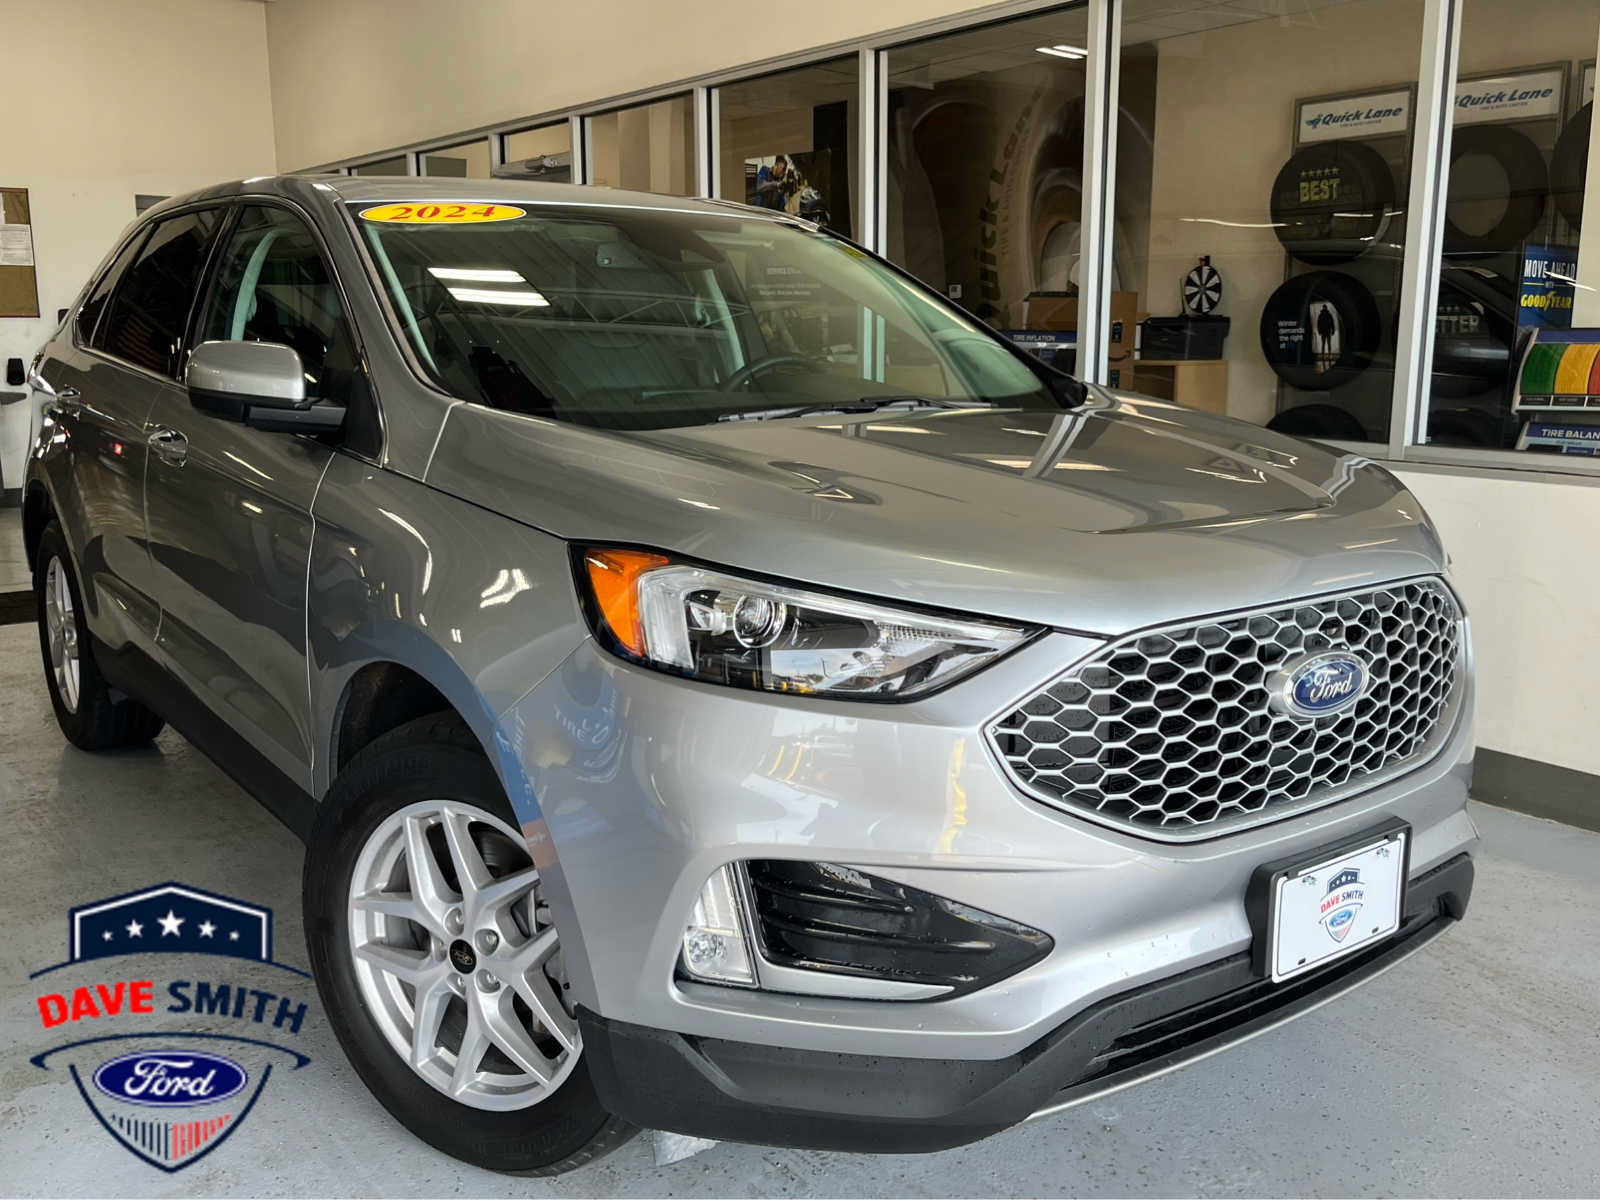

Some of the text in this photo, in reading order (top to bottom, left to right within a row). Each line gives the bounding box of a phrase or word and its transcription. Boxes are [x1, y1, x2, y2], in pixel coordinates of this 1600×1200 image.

[1459, 91, 1505, 108] Quick
[1508, 88, 1553, 102] Lane
[1322, 110, 1363, 126] Quick
[1365, 107, 1404, 120] Lane
[1299, 178, 1341, 202] BEST
[390, 206, 496, 220] 2024
[1524, 259, 1548, 278] MOVE
[1521, 291, 1572, 311] GOODYEAR
[1541, 428, 1564, 438] TIRE
[1310, 667, 1353, 703] Ford
[1320, 890, 1363, 913] DAVE SMITH
